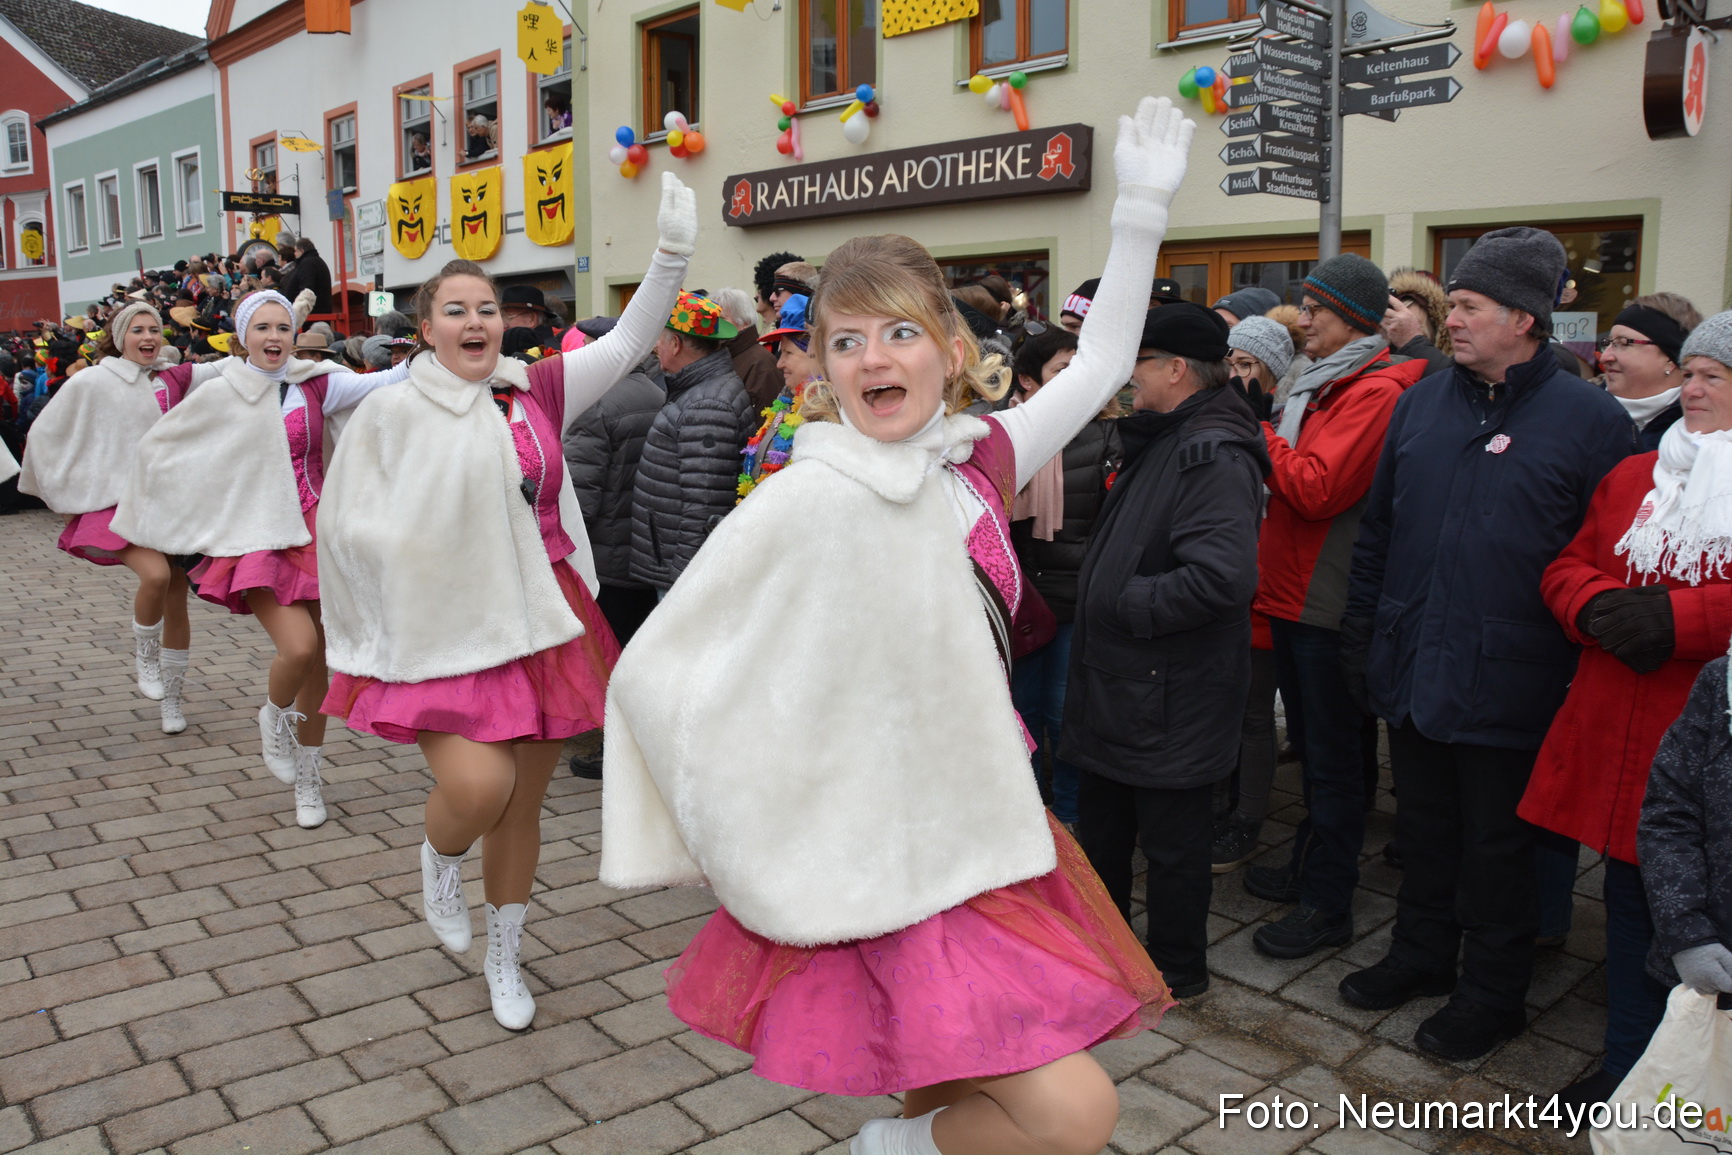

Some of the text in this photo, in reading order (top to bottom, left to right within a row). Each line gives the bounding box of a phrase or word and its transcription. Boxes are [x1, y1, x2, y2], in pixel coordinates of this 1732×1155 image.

[1276, 6, 1315, 28] Museum im
[1277, 19, 1314, 40] Hollerhaus
[1263, 44, 1323, 70] Wassertretanlage
[1366, 55, 1430, 75] Keltenhaus
[1263, 71, 1321, 94] Meditationshaus
[1260, 82, 1323, 105] Franziskanerkloster
[1370, 86, 1436, 105] Barfußpark
[1271, 105, 1318, 124] Mariengrotte
[1279, 118, 1315, 138] Kreuzberg
[1265, 142, 1320, 163] Franziskuspark
[756, 165, 874, 212] RATHAUS
[878, 143, 1033, 195] APOTHEKE
[1271, 171, 1313, 187] Kulturhaus
[1266, 182, 1318, 199] Stadtbücherei
